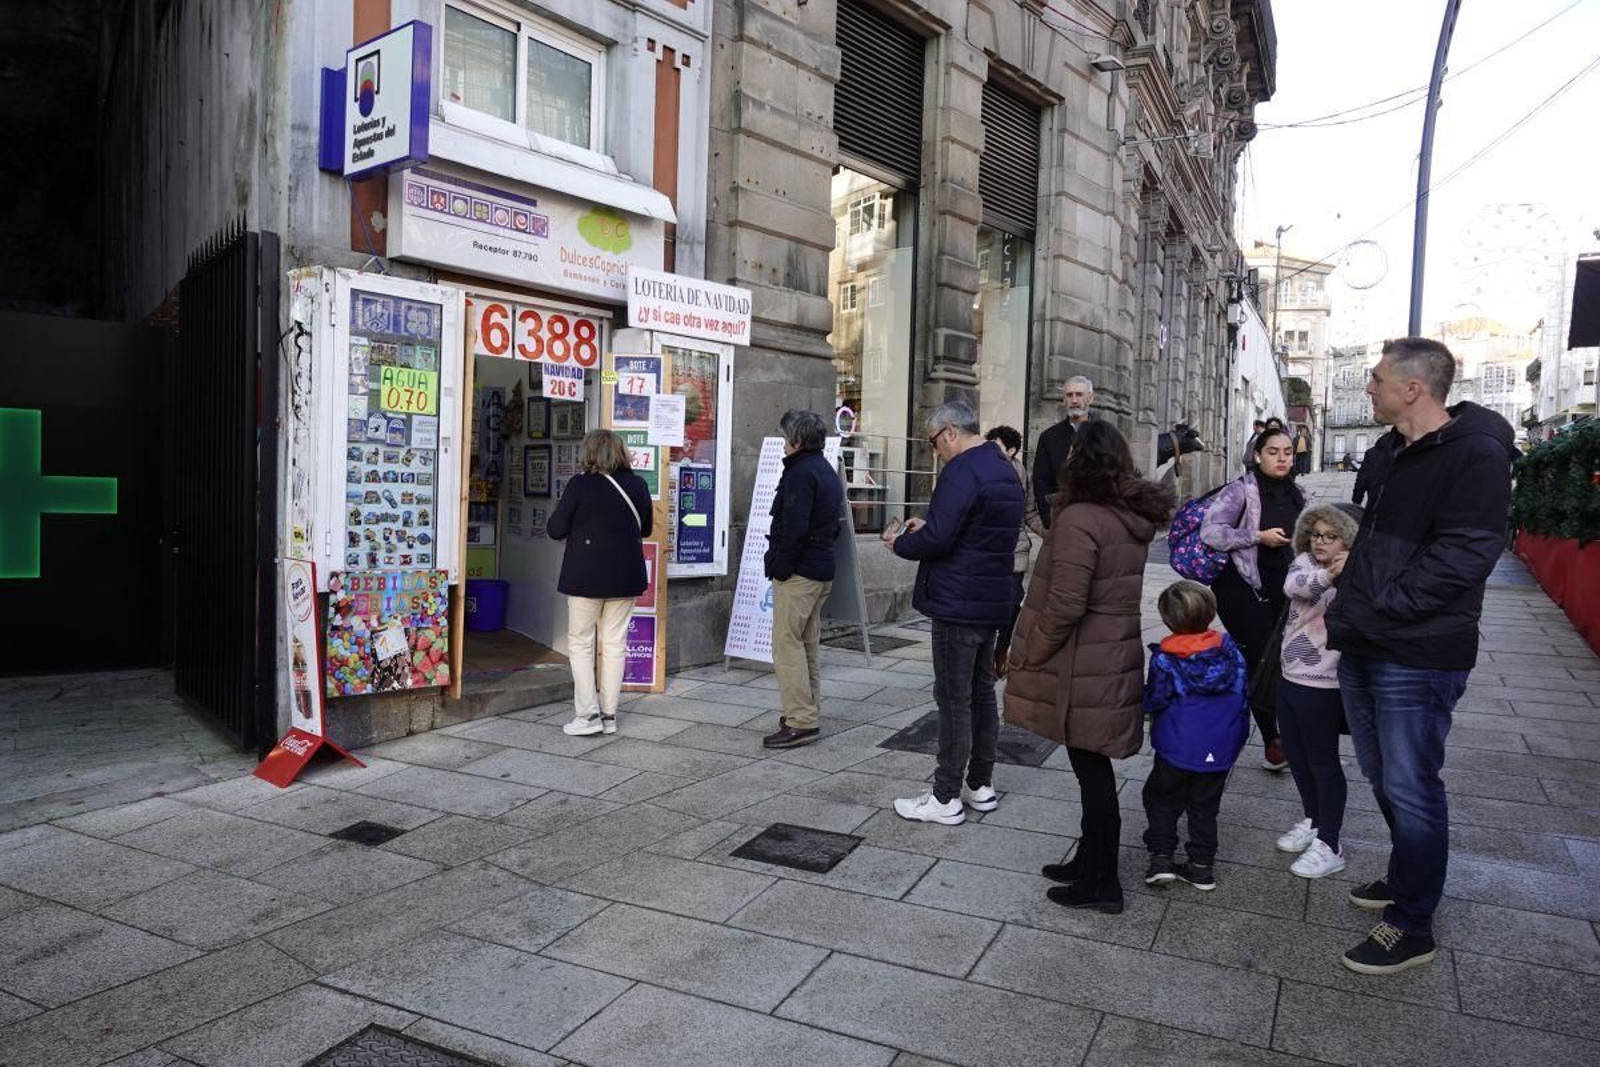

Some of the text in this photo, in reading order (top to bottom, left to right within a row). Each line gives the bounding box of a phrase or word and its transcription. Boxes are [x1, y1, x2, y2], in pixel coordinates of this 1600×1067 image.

[352, 124, 396, 150] Apuestas del
[352, 147, 375, 163] Estado
[473, 241, 509, 257] Receptor
[634, 276, 750, 316] LOTERÍA DE NAVIDAD
[664, 309, 681, 324] cae
[684, 311, 702, 328] otra
[704, 318, 720, 332] vez
[465, 299, 598, 367] 6388
[543, 363, 583, 380] NAVIDAD
[629, 360, 647, 371] BOTE
[382, 367, 428, 390] AGUA
[550, 379, 565, 396] 20
[627, 376, 645, 394] 17
[387, 387, 428, 411] 0.70
